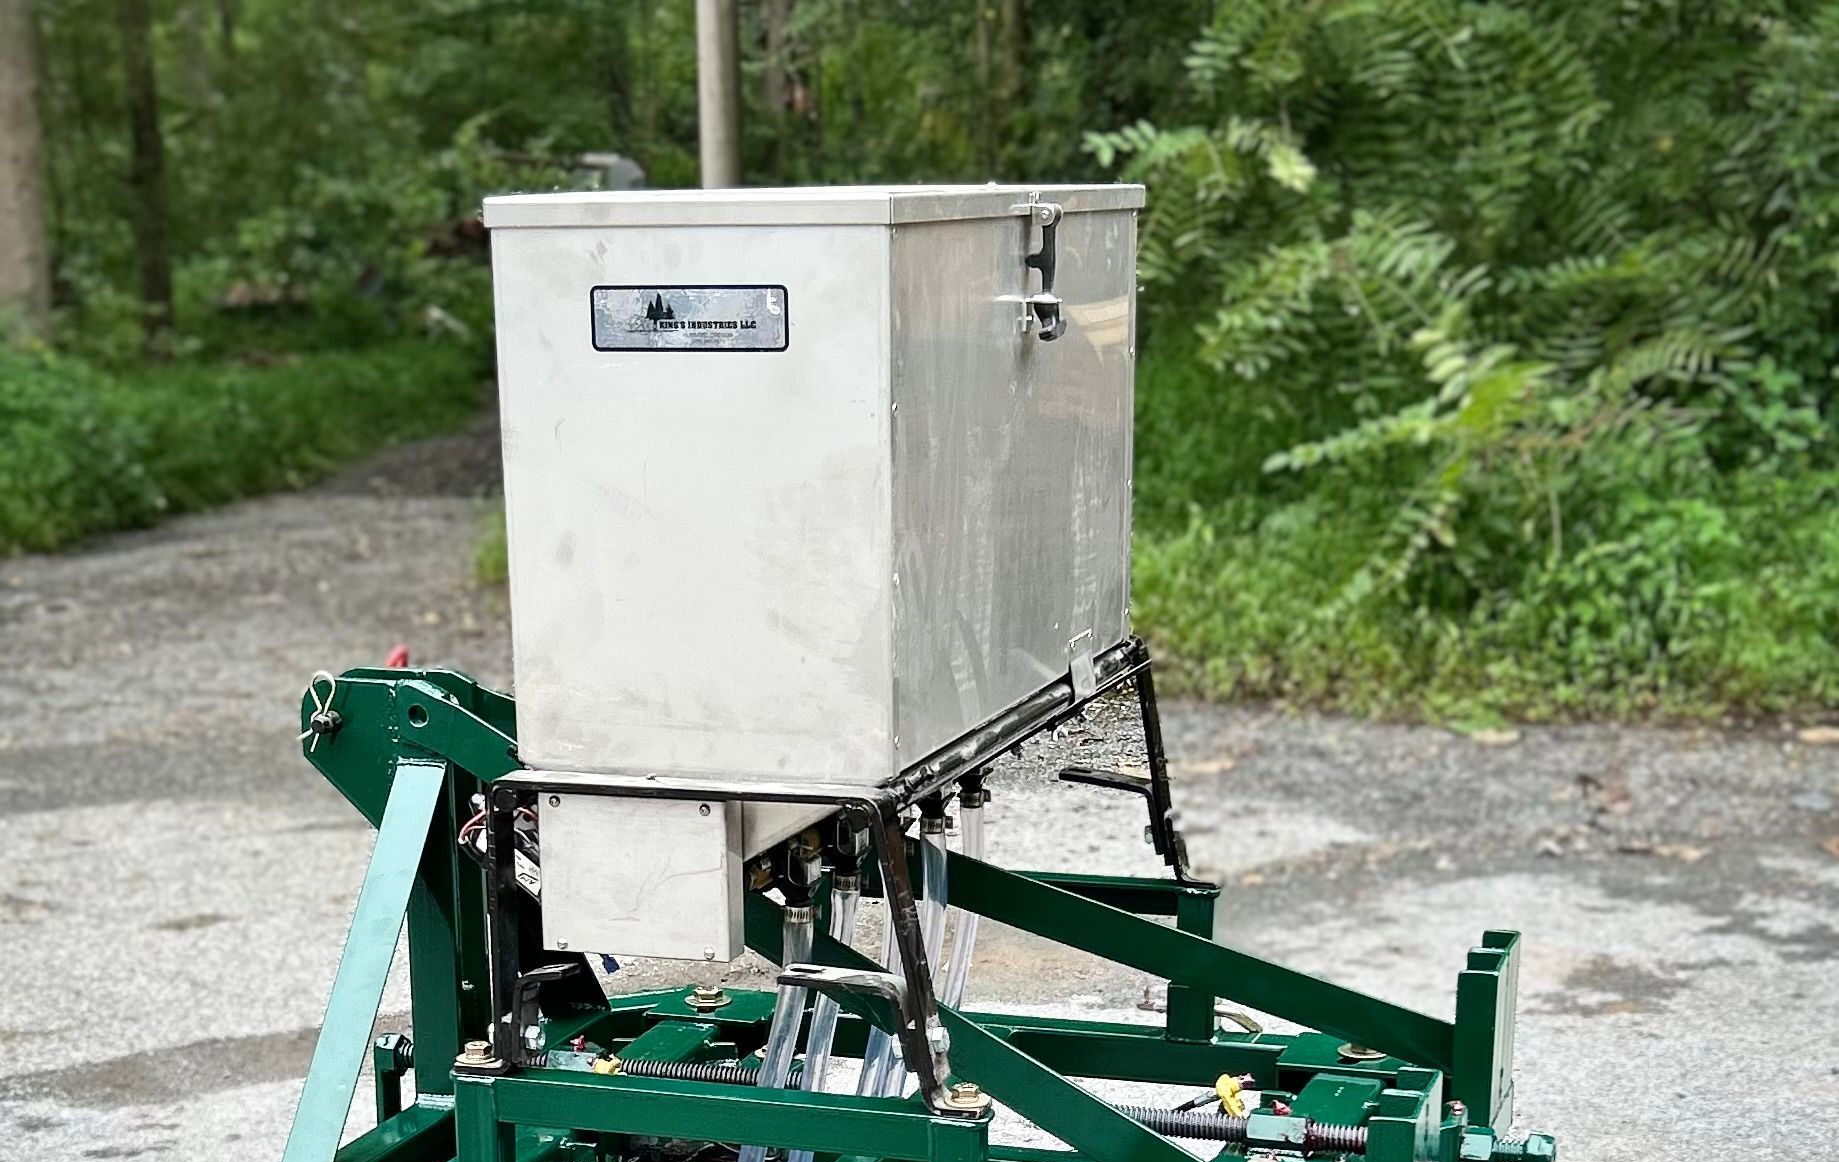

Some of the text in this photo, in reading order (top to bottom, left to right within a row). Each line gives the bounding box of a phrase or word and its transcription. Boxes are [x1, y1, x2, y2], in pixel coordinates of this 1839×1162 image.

[660, 320, 757, 329] KING'S INDUSTRIES LLC
